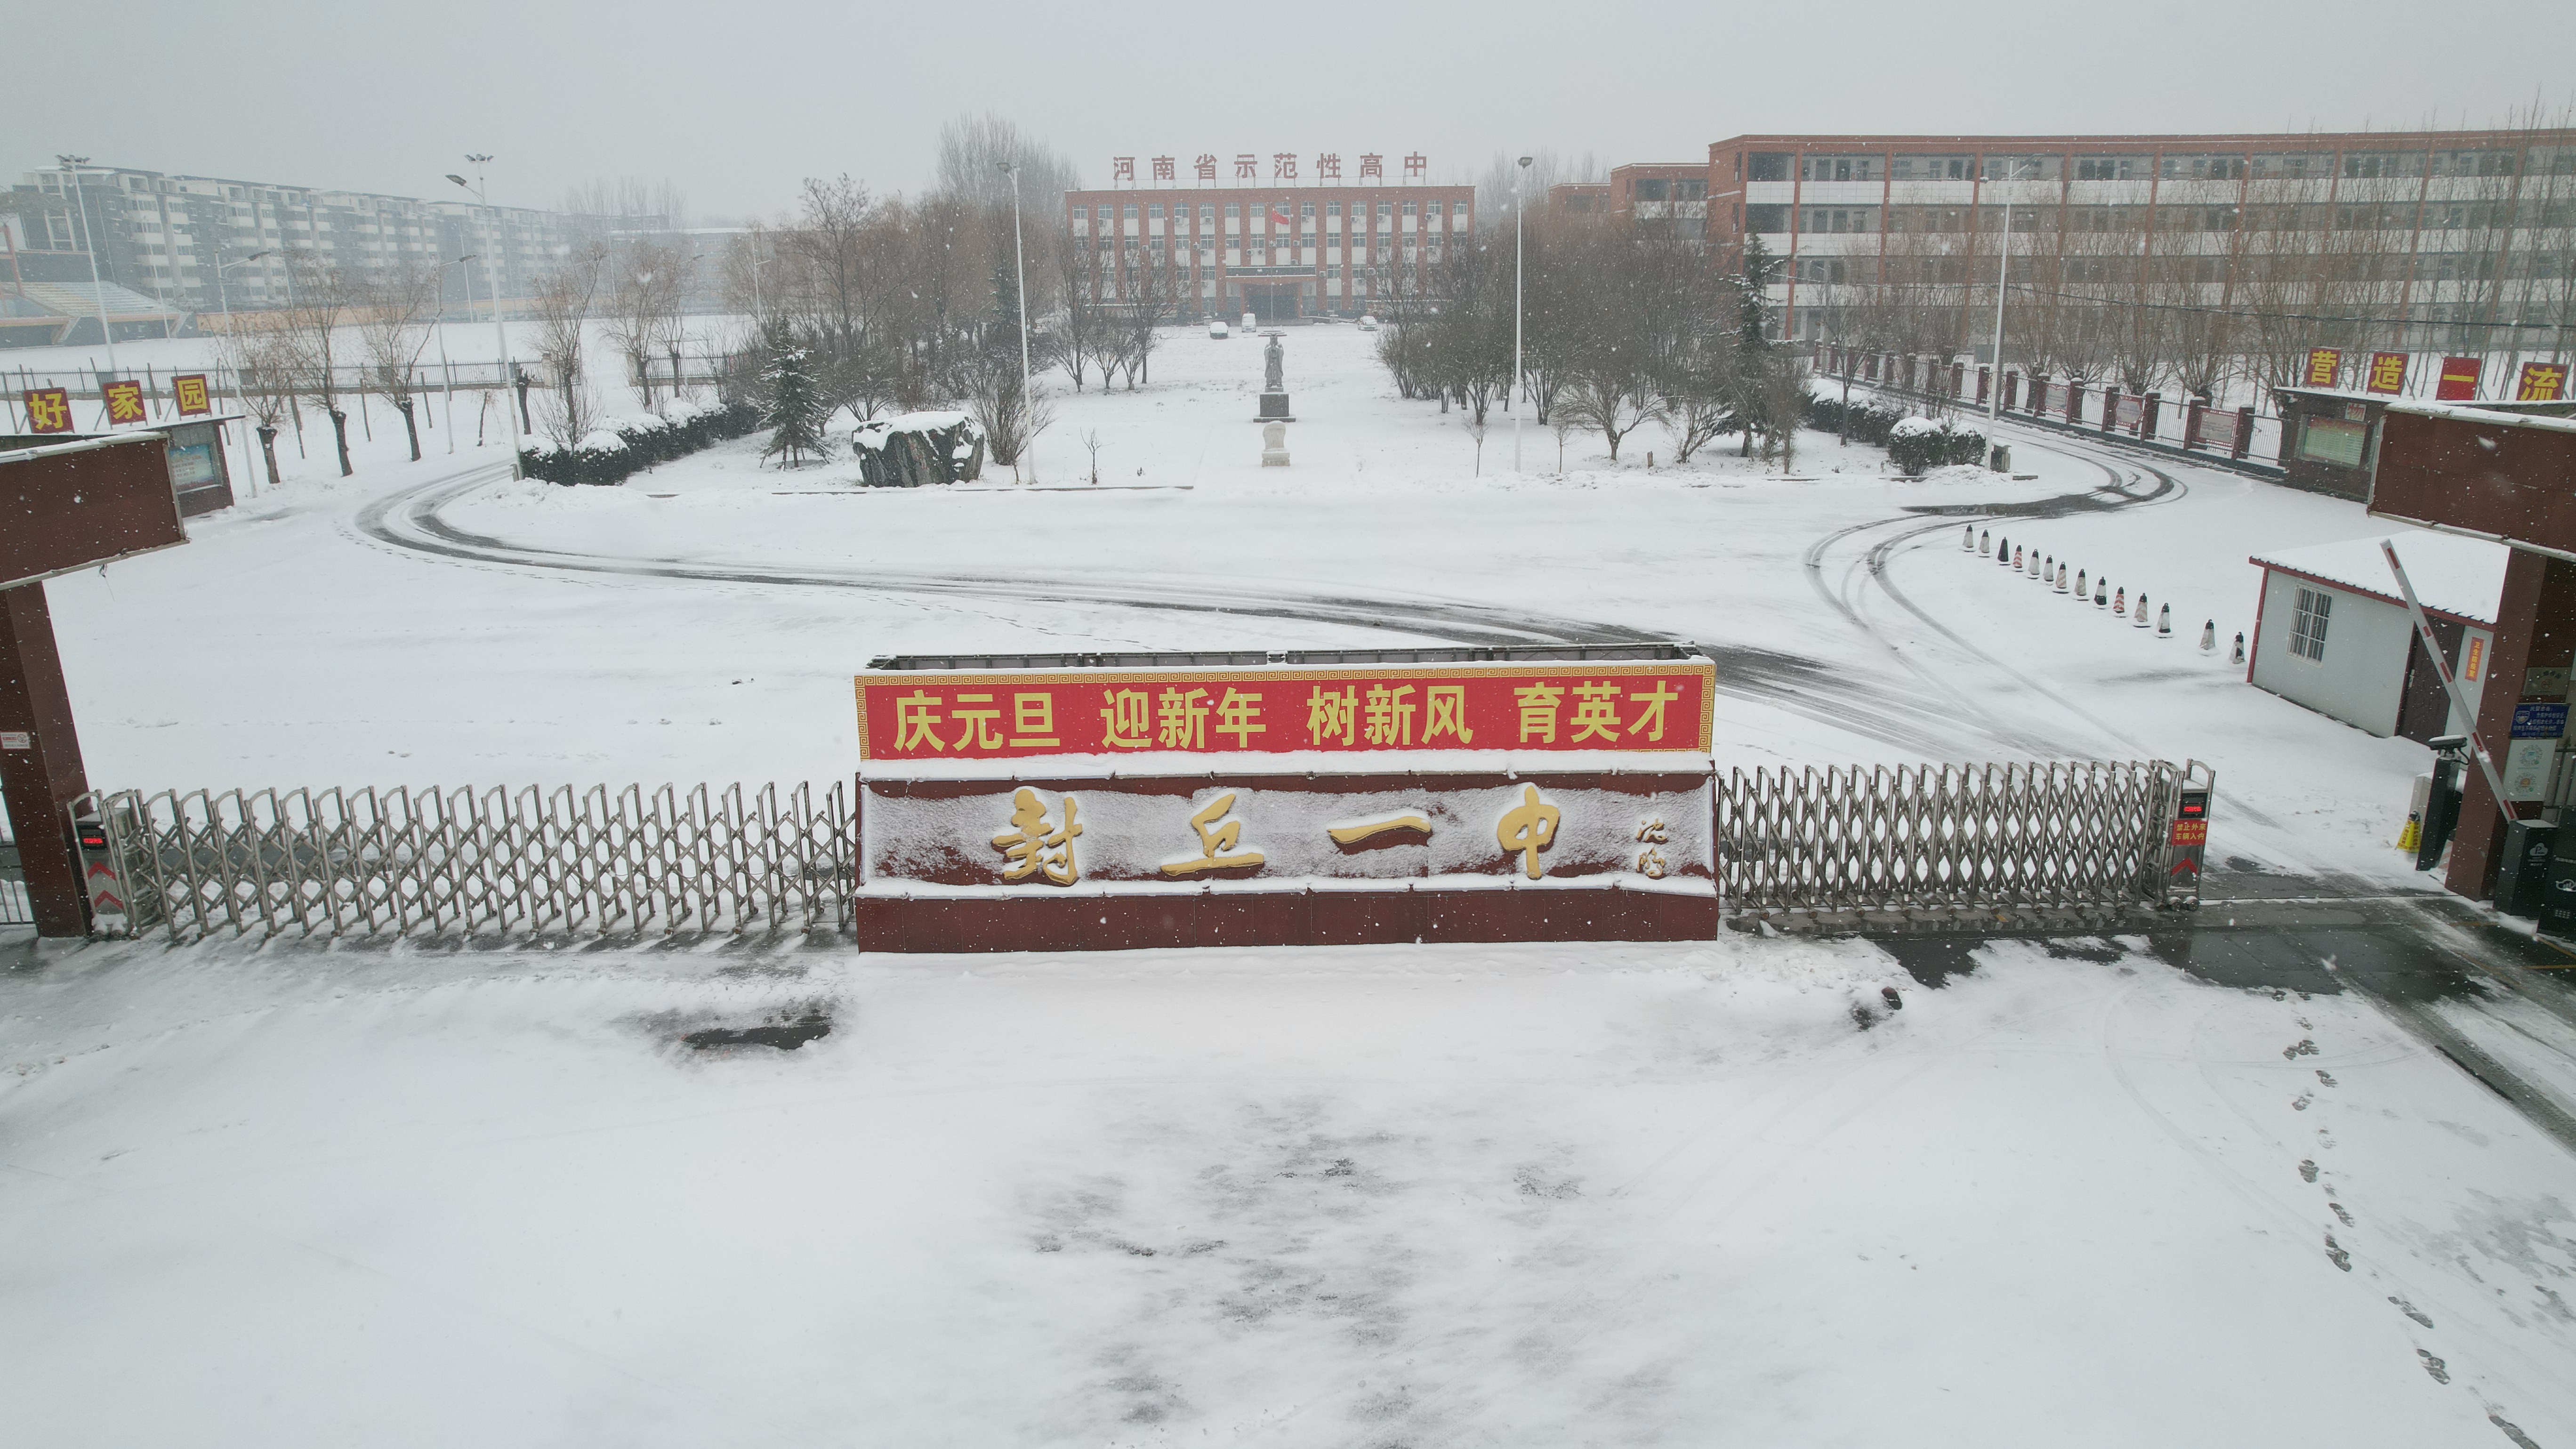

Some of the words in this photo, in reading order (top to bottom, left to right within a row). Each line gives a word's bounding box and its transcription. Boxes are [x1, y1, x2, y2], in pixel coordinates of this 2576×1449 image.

[1112, 152, 1427, 181] 河南省示范性高中
[2310, 351, 2562, 401] 营造一流
[29, 378, 207, 429] 好家园
[895, 689, 1060, 751] 庆元旦
[1101, 686, 1266, 749] 迎新年
[1306, 684, 1473, 746] 树新风
[1514, 680, 1679, 743] 育英才
[991, 787, 1560, 885] 封丘一中
[2175, 832, 2205, 841] 车辆入内
[2177, 823, 2206, 831] 禁止外来
